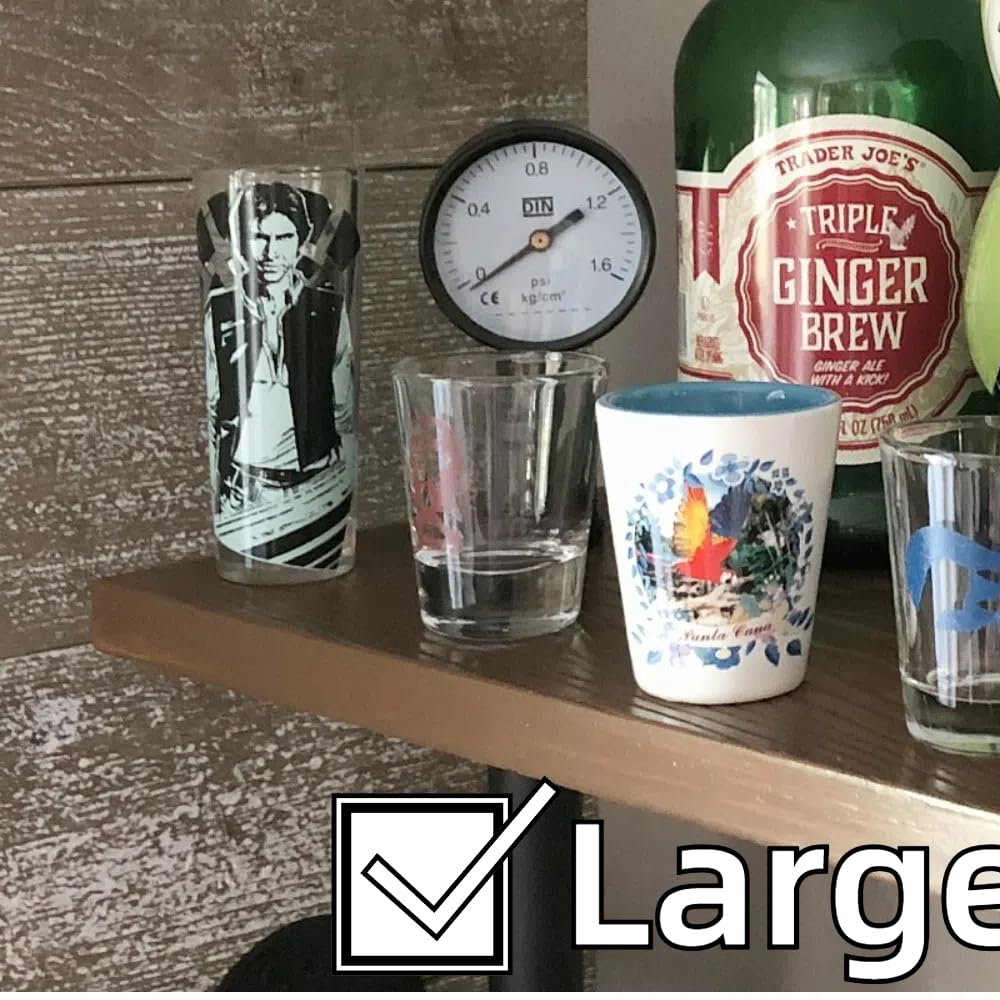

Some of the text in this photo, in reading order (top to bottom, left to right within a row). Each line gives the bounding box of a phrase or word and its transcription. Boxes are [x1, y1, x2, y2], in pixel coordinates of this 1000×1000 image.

[775, 145, 919, 177] TRADER JOE'S
[525, 162, 549, 177] 0.8
[467, 202, 490, 217] 0.4
[523, 198, 554, 215] DIN
[586, 195, 608, 209] 1.2
[800, 204, 899, 236] TRIPLE
[591, 258, 612, 272] 1.6
[531, 278, 551, 288] psi
[773, 256, 929, 307] GINGER
[800, 310, 908, 351] BREW
[814, 359, 886, 372] GINGER ALE
[810, 372, 890, 386] WITH A KICK!
[852, 417, 869, 436] OZ
